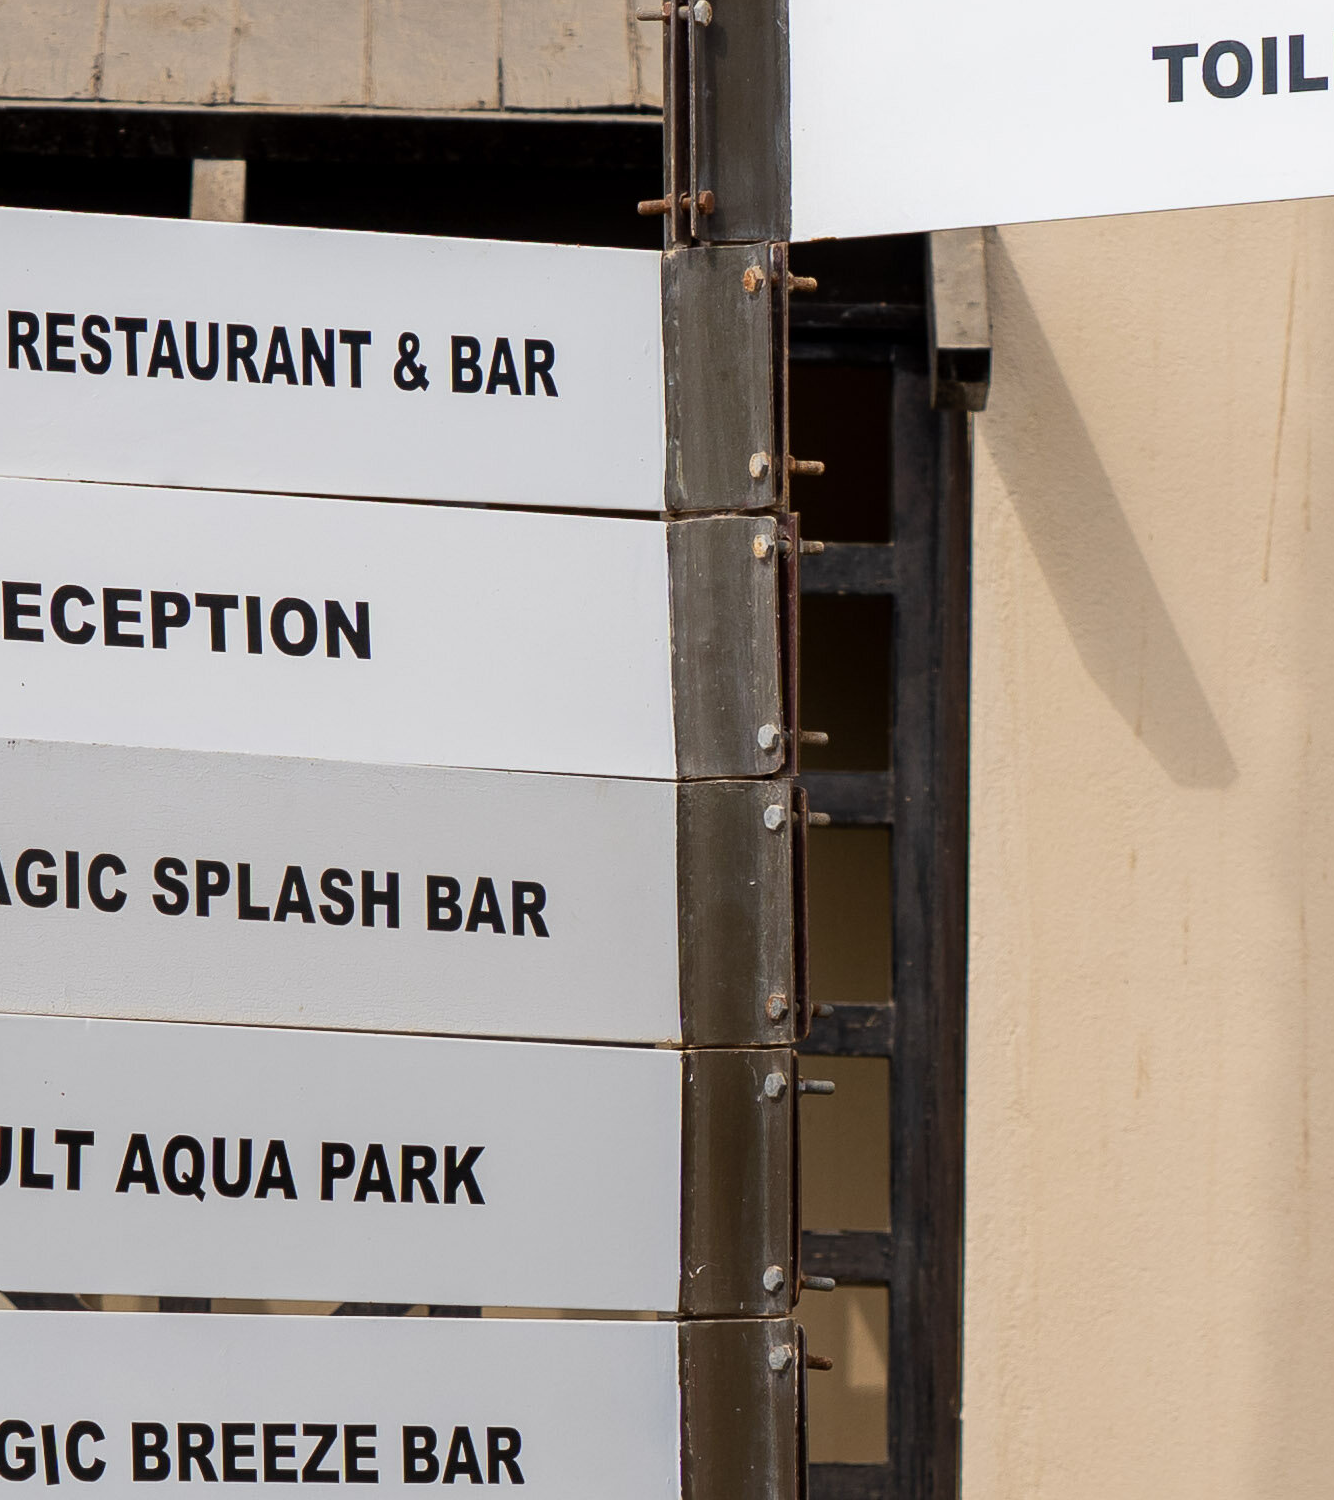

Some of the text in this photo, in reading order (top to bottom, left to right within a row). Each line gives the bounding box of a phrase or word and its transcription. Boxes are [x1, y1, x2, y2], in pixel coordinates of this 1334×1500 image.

[7, 309, 372, 389] RESTAURANT
[393, 331, 430, 392] &
[450, 335, 559, 398] BAR
[152, 856, 400, 929] SPLASH
[426, 874, 550, 938] BAR
[115, 1133, 298, 1203] AQUA
[320, 1141, 486, 1205] PARK
[131, 1421, 379, 1484] BREEZE
[402, 1425, 525, 1485] BAR
